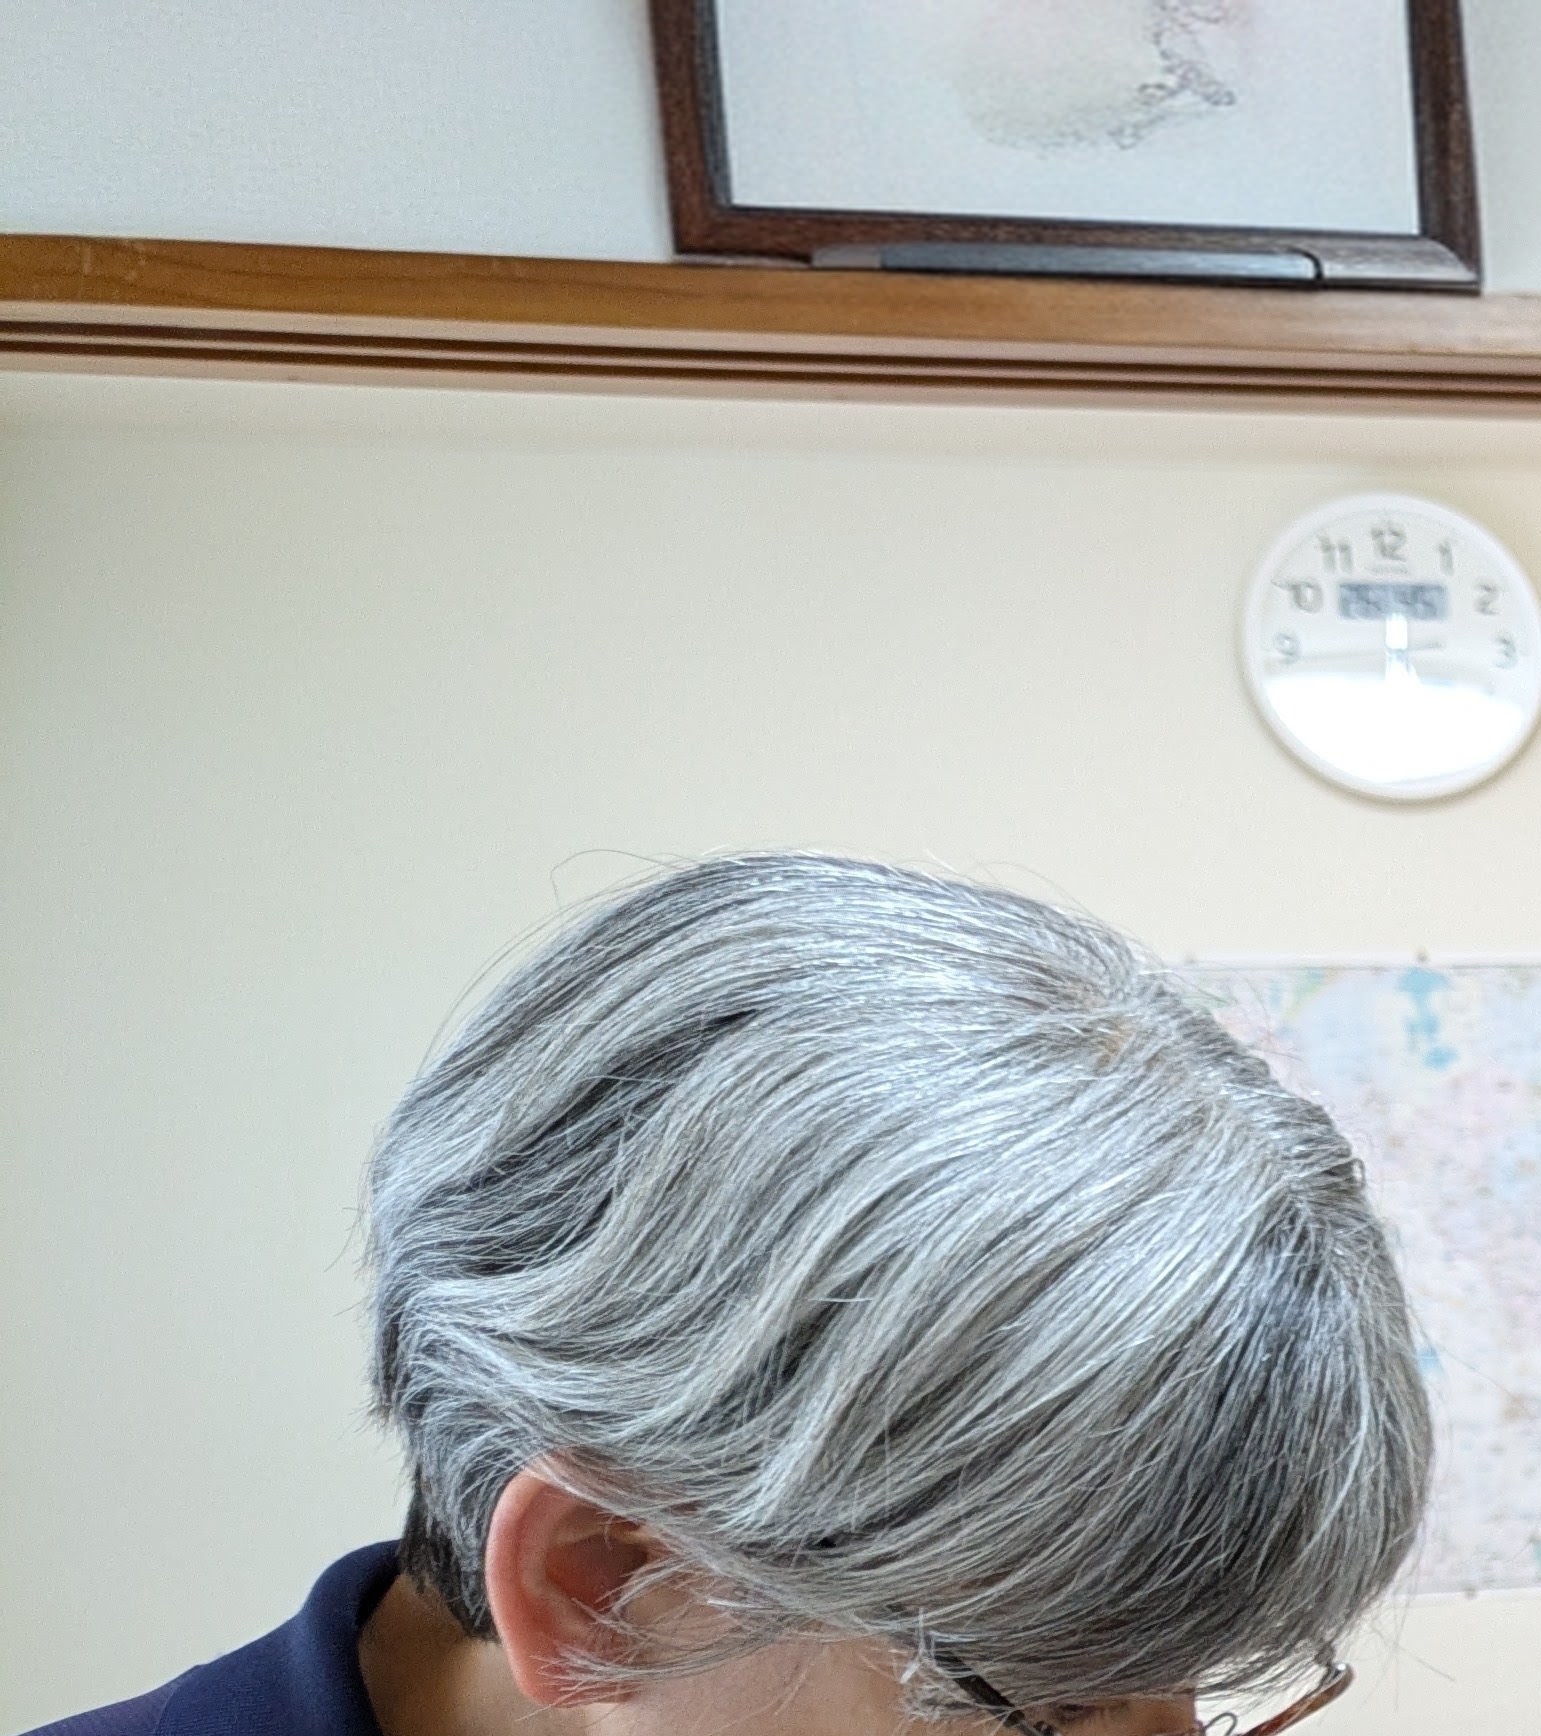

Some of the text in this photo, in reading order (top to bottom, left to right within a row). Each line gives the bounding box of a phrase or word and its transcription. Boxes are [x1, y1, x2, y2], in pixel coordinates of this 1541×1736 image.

[1318, 535, 1353, 574] 11
[1371, 521, 1407, 563] 12
[1439, 540, 1454, 576] 1
[1271, 576, 1324, 613] 10
[1476, 582, 1500, 616] 2
[1273, 631, 1299, 665] 9
[1494, 635, 1518, 669] 3
